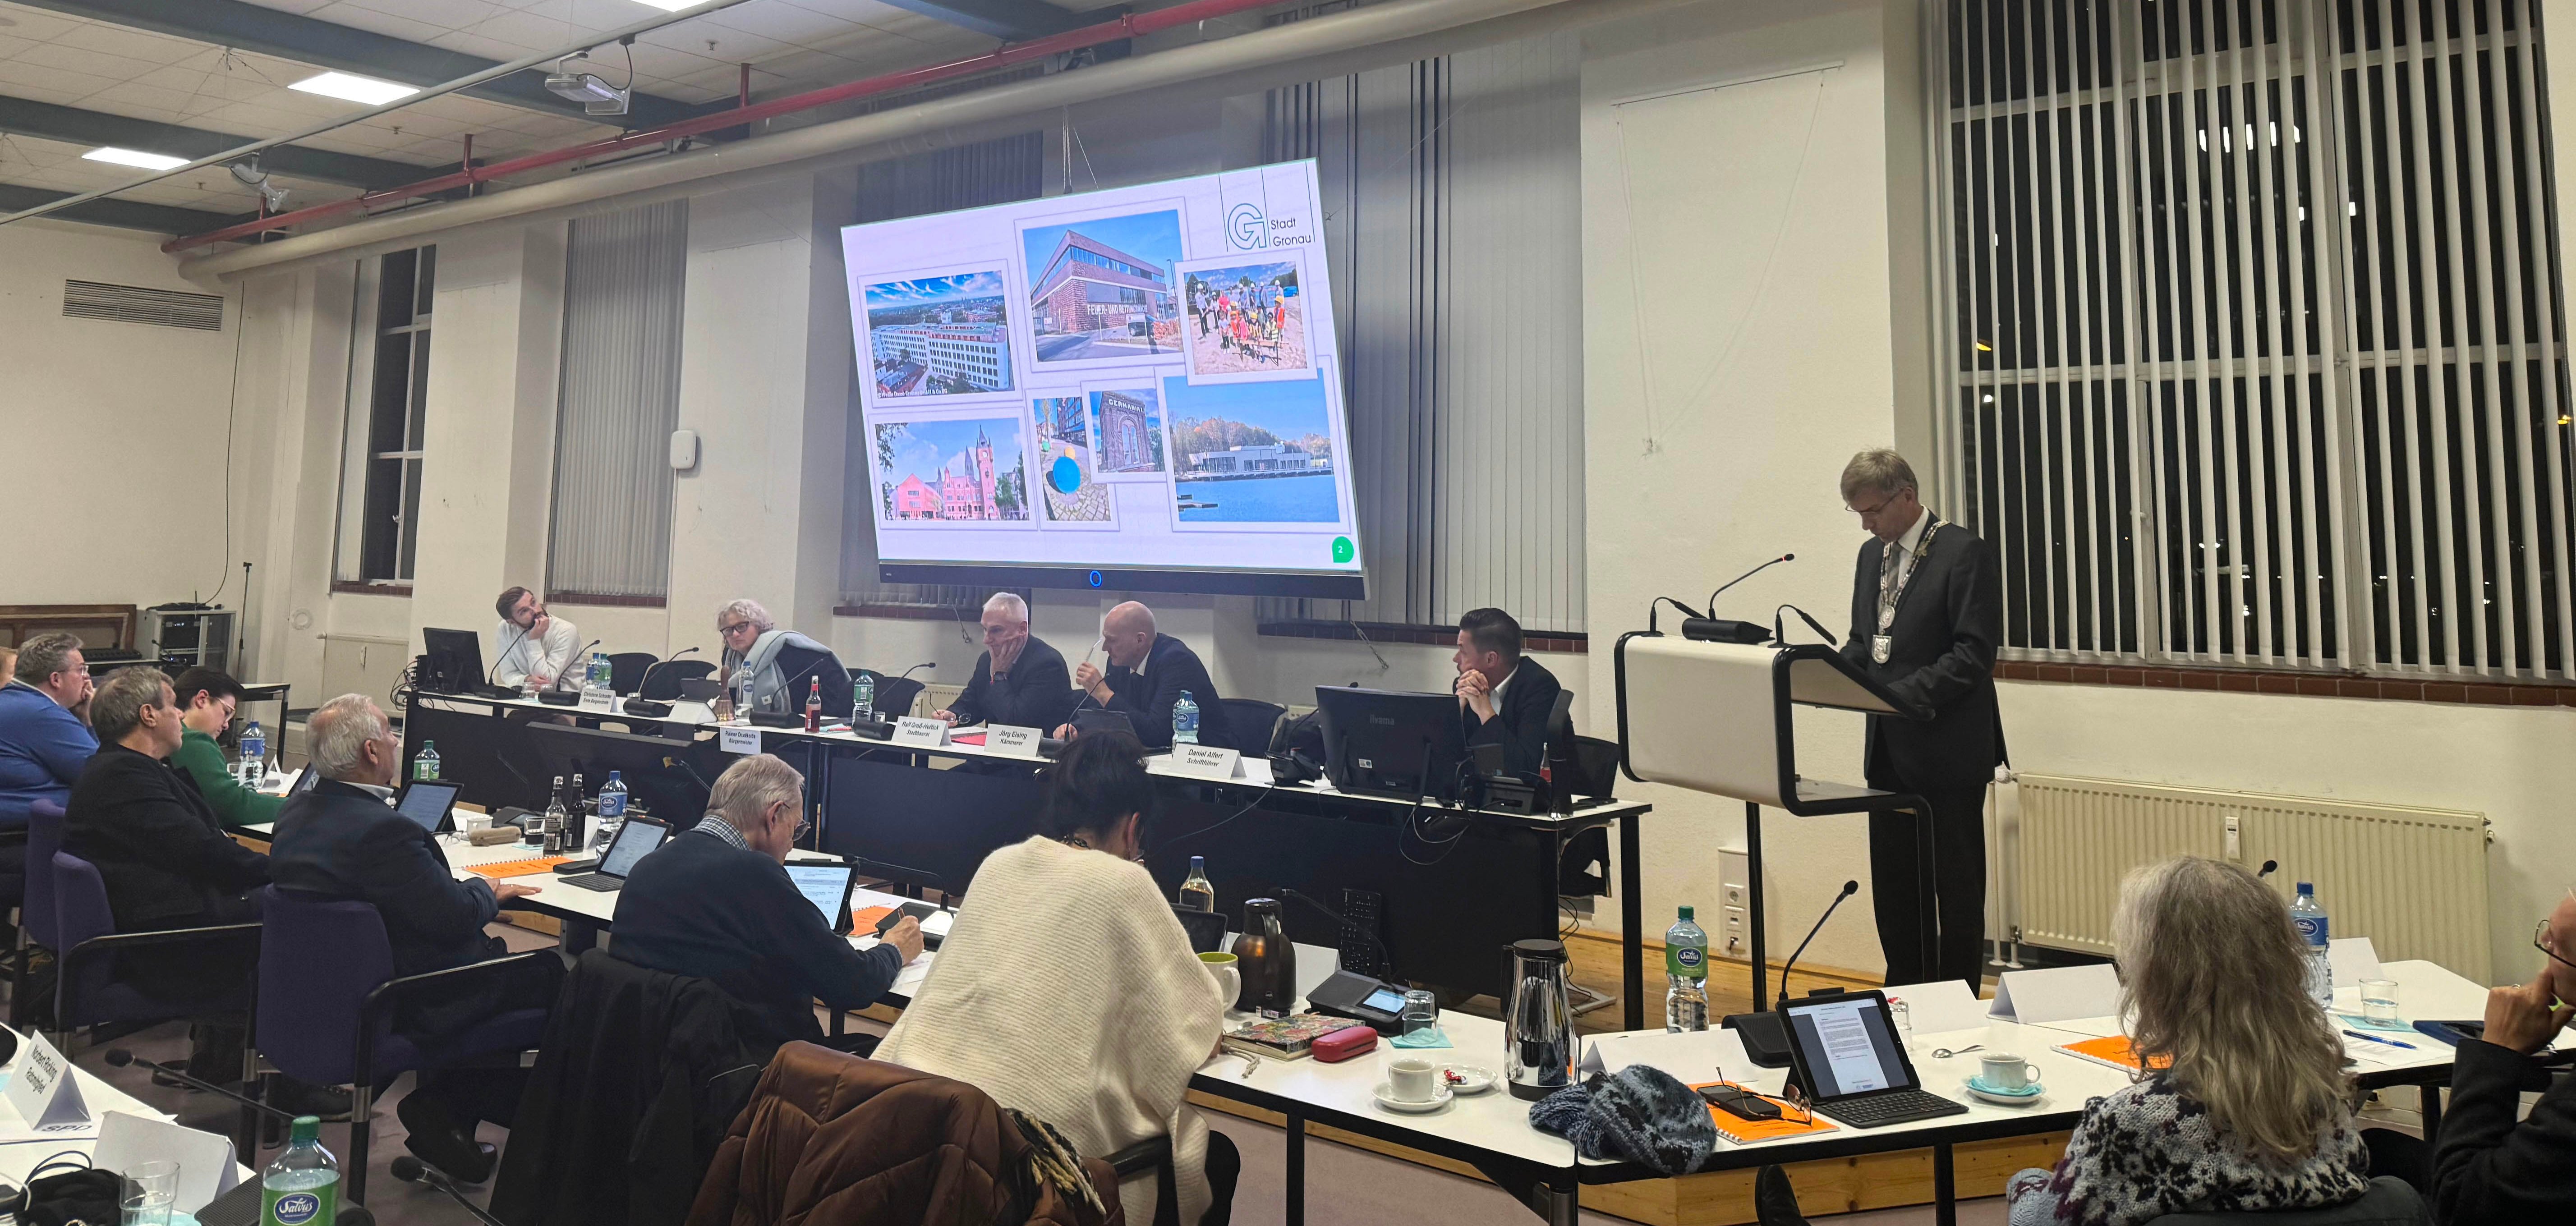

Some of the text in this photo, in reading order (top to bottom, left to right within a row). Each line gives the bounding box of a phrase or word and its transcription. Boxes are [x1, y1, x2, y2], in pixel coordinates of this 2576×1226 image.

[1270, 217, 1296, 230] Stadt
[1273, 234, 1311, 247] Gronau
[1108, 305, 1118, 315] UND
[1338, 545, 1343, 554] 2
[999, 730, 1027, 740] Jörg Eising
[1188, 749, 1207, 757] Daniel
[1187, 758, 1219, 767] Schriftführer
[279, 1197, 313, 1214] Salvus
